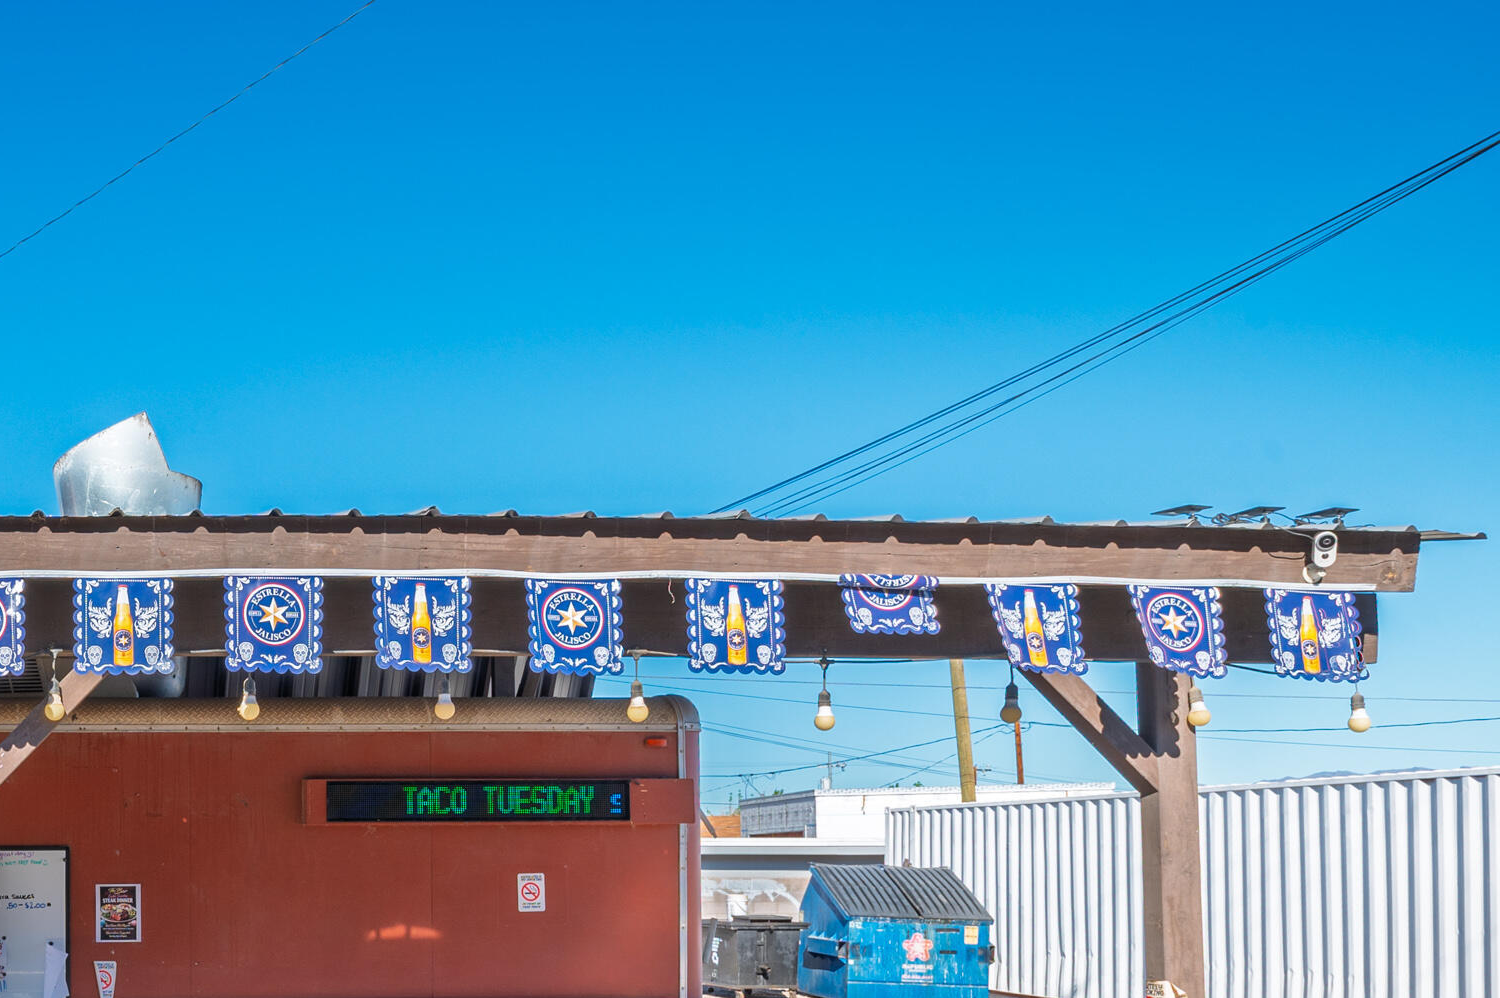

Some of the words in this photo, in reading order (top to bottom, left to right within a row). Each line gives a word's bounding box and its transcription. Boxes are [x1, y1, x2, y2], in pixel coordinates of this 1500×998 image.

[250, 588, 296, 608] ESTRELLA
[550, 592, 595, 611] ESTRELLA
[1151, 599, 1193, 617] ESTRELLA
[255, 628, 291, 640] JALISCO
[555, 632, 591, 644] JALISCO
[1160, 633, 1190, 647] JALISCO
[403, 786, 467, 815] TACO
[482, 786, 595, 815] TUESDAY
